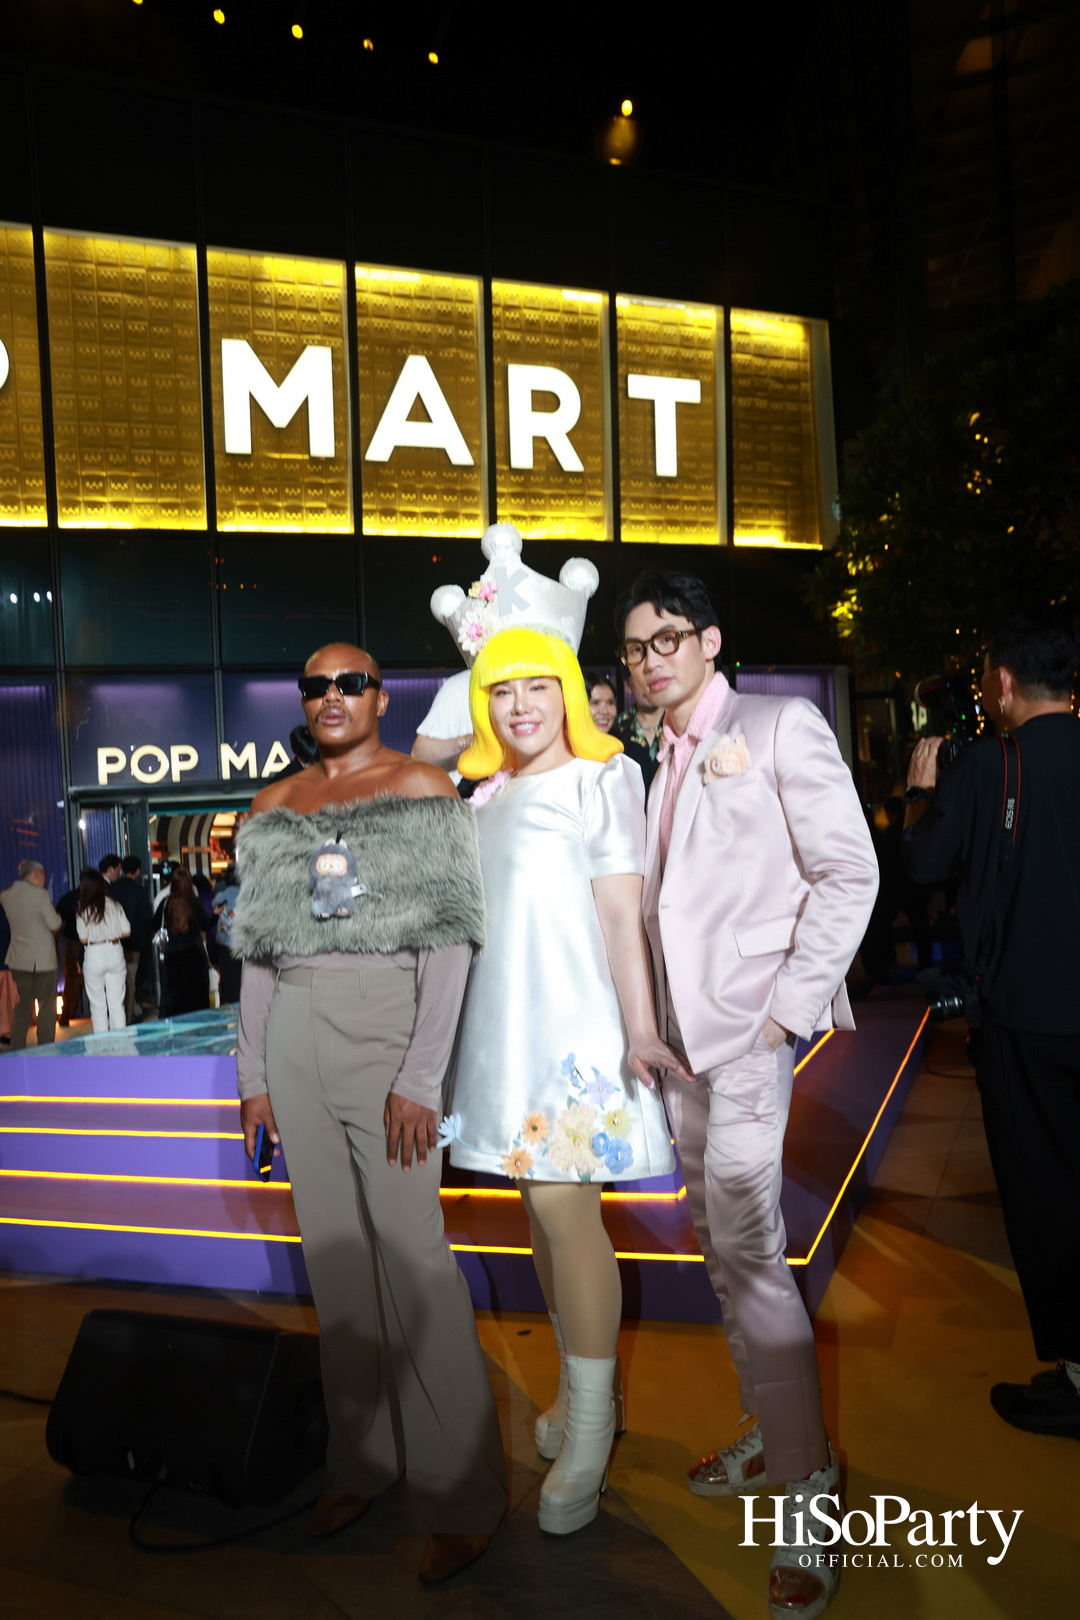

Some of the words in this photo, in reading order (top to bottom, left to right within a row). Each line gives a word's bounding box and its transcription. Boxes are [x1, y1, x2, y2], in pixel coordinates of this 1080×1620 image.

[221, 338, 702, 477] MART
[96, 744, 199, 785] POP
[219, 740, 291, 780] MA
[1004, 809, 1014, 829] EOS
